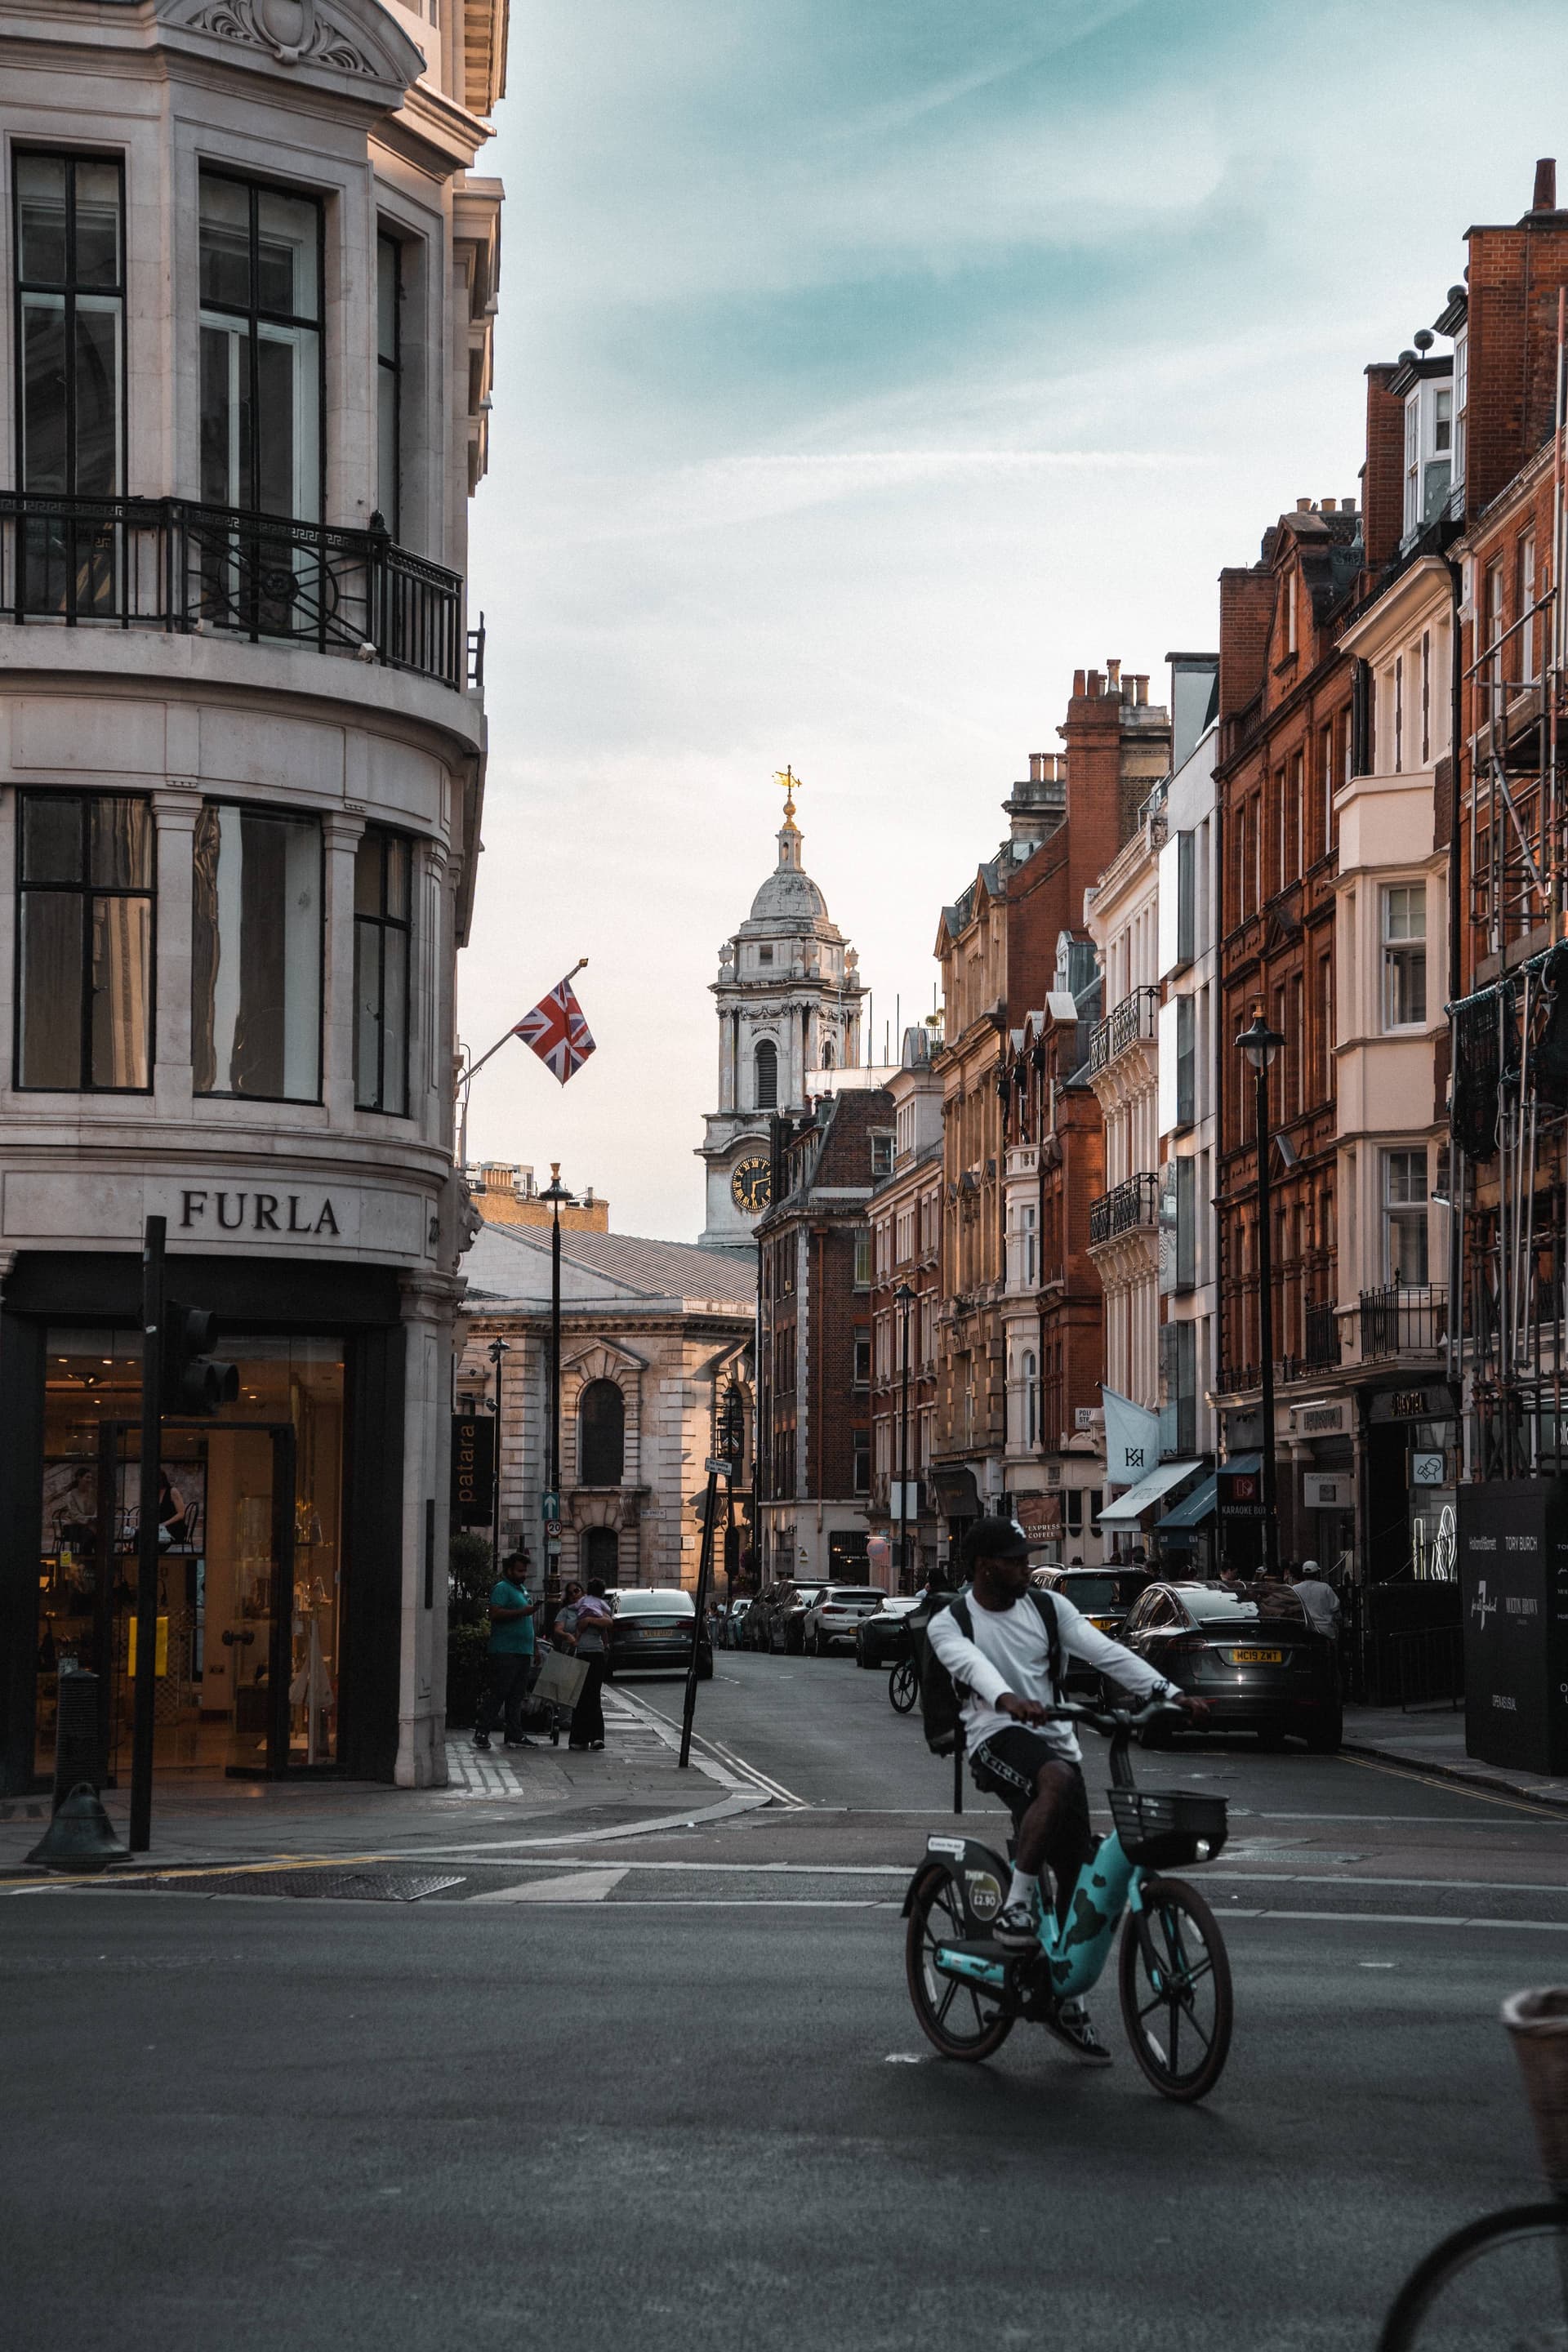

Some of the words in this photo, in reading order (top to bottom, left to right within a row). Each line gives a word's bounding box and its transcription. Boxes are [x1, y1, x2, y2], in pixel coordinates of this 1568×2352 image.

[180, 1190, 341, 1235] FURLA
[457, 1423, 477, 1503] patara
[1222, 1504, 1253, 1516] KARAOKE
[1505, 1536, 1519, 1551] TORY
[1519, 1536, 1538, 1551] BURCH
[973, 1895, 996, 1907] £2.90
